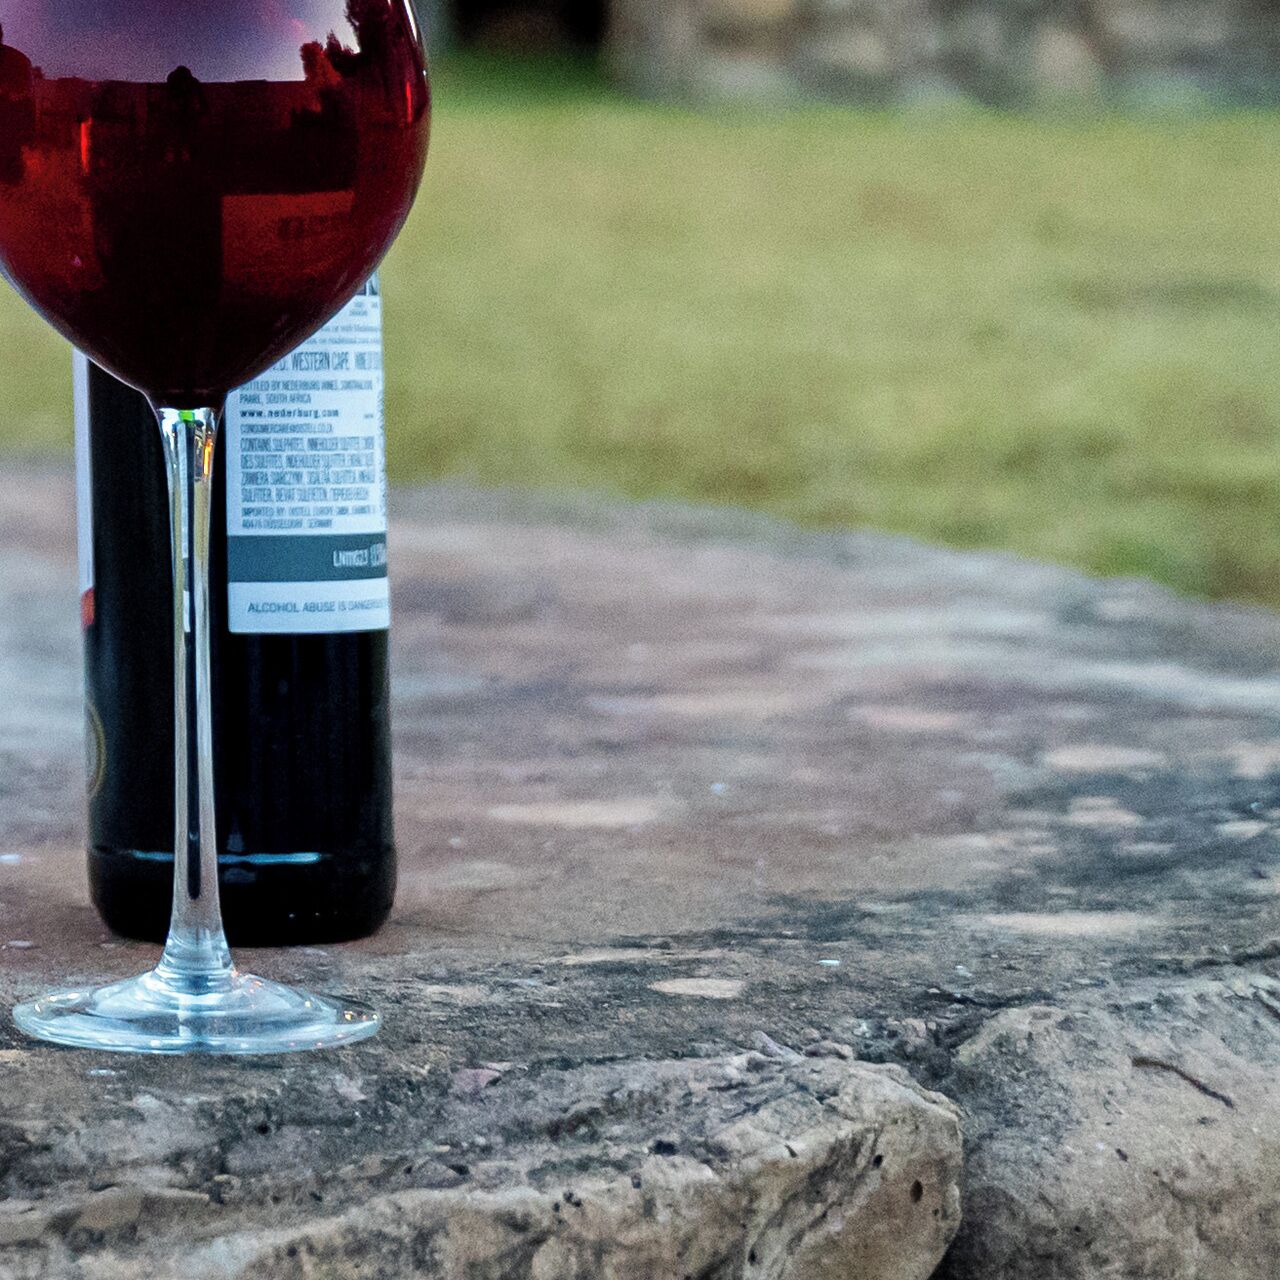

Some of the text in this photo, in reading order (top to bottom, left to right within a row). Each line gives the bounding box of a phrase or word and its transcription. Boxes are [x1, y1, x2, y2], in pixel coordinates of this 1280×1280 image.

[291, 351, 330, 371] WESTERN
[332, 351, 349, 371] CAPE
[271, 380, 280, 391] BY
[282, 380, 319, 391] NEDERBURG
[265, 393, 287, 405] SOUTH
[289, 393, 311, 404] AFRICA
[240, 408, 339, 418] www.nederburg.com
[248, 602, 300, 613] ALCOHOL
[303, 601, 335, 612] ABUSE
[338, 601, 347, 611] IS
